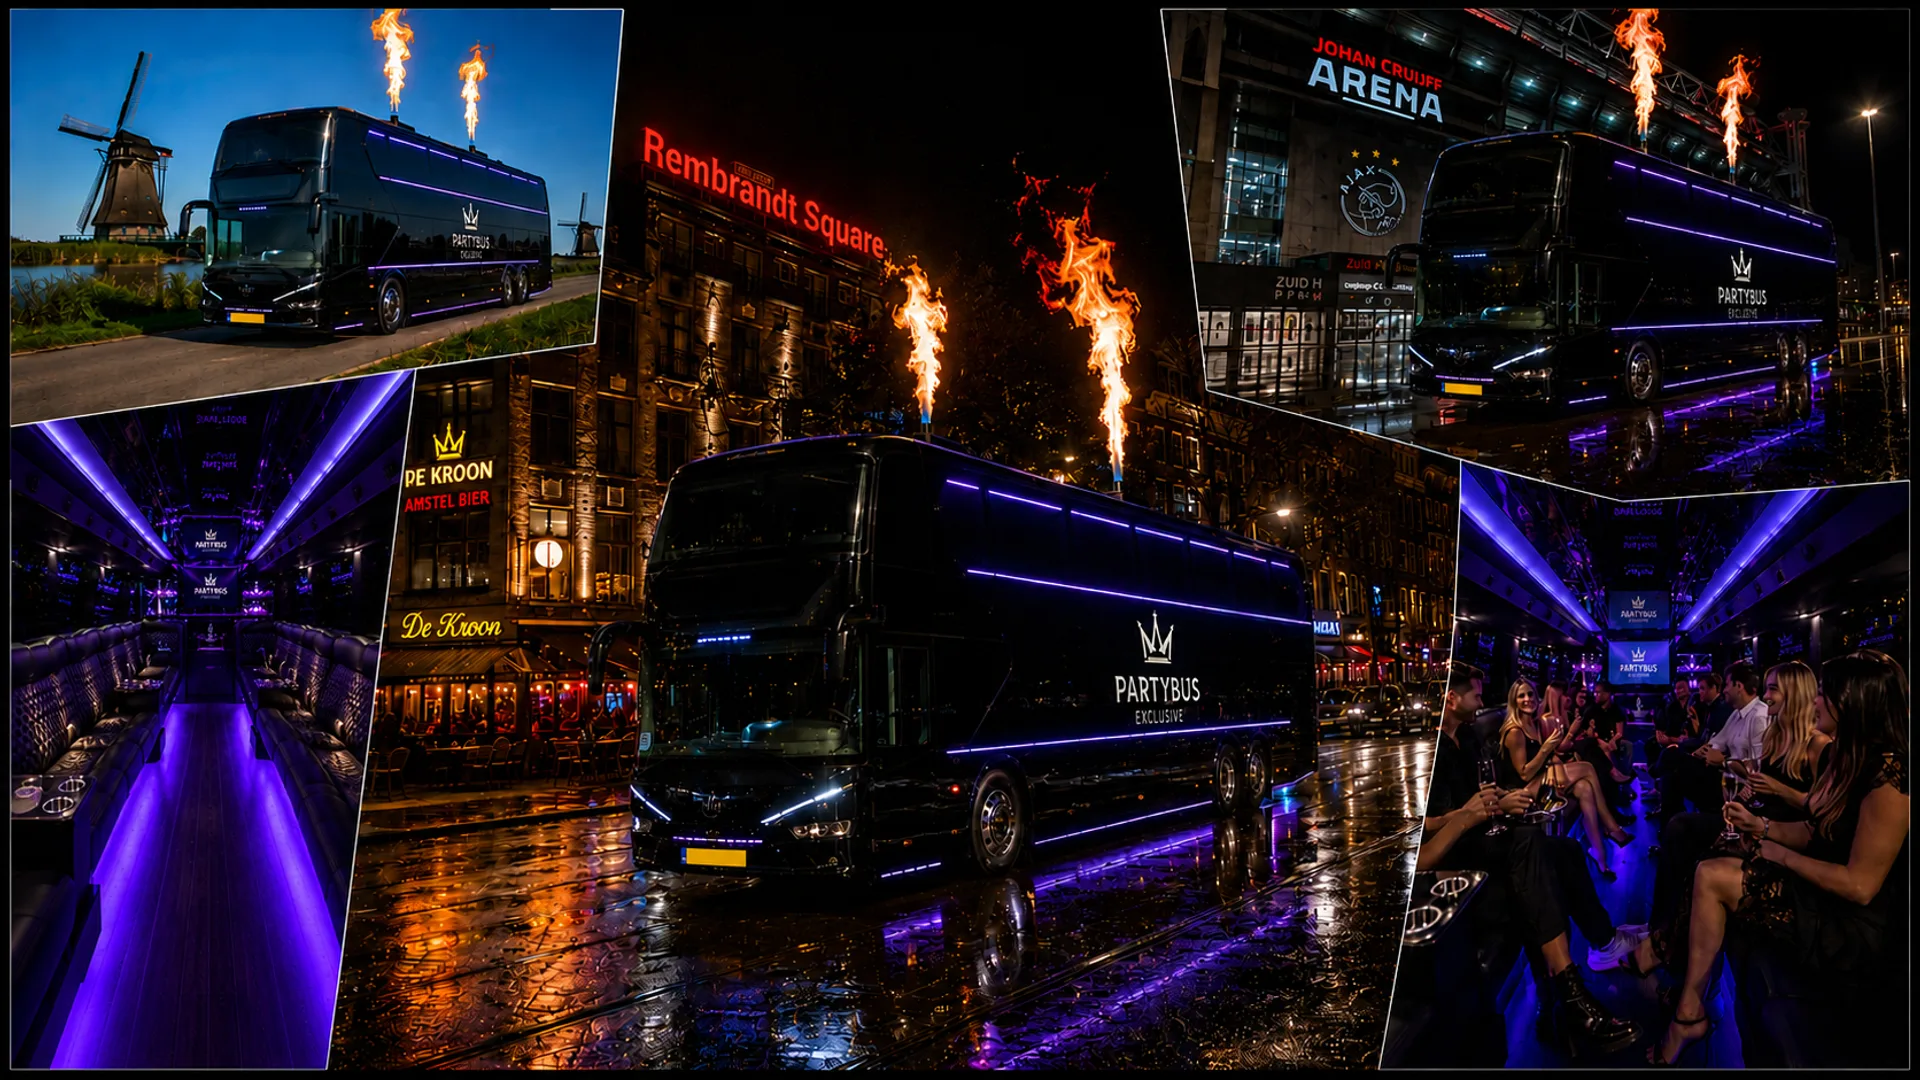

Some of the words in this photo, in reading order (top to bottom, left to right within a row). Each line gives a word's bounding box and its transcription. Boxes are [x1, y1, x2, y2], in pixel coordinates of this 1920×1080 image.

[1312, 37, 1376, 69] JOHAN
[1381, 58, 1443, 91] CRUIJFF
[643, 126, 798, 225] Rembrandt
[803, 200, 885, 259] Square
[1340, 165, 1376, 195] AJAX
[1275, 275, 1310, 289] ZUID
[1717, 286, 1768, 306] PARTYBUS
[431, 460, 493, 485] KROON
[404, 494, 456, 513] AMSTEL
[459, 490, 490, 507] BIER
[401, 611, 432, 639] De
[437, 612, 502, 638] Kroon
[1114, 675, 1201, 703] PARTYBUS
[1135, 708, 1184, 725] EXCLUSIVE
